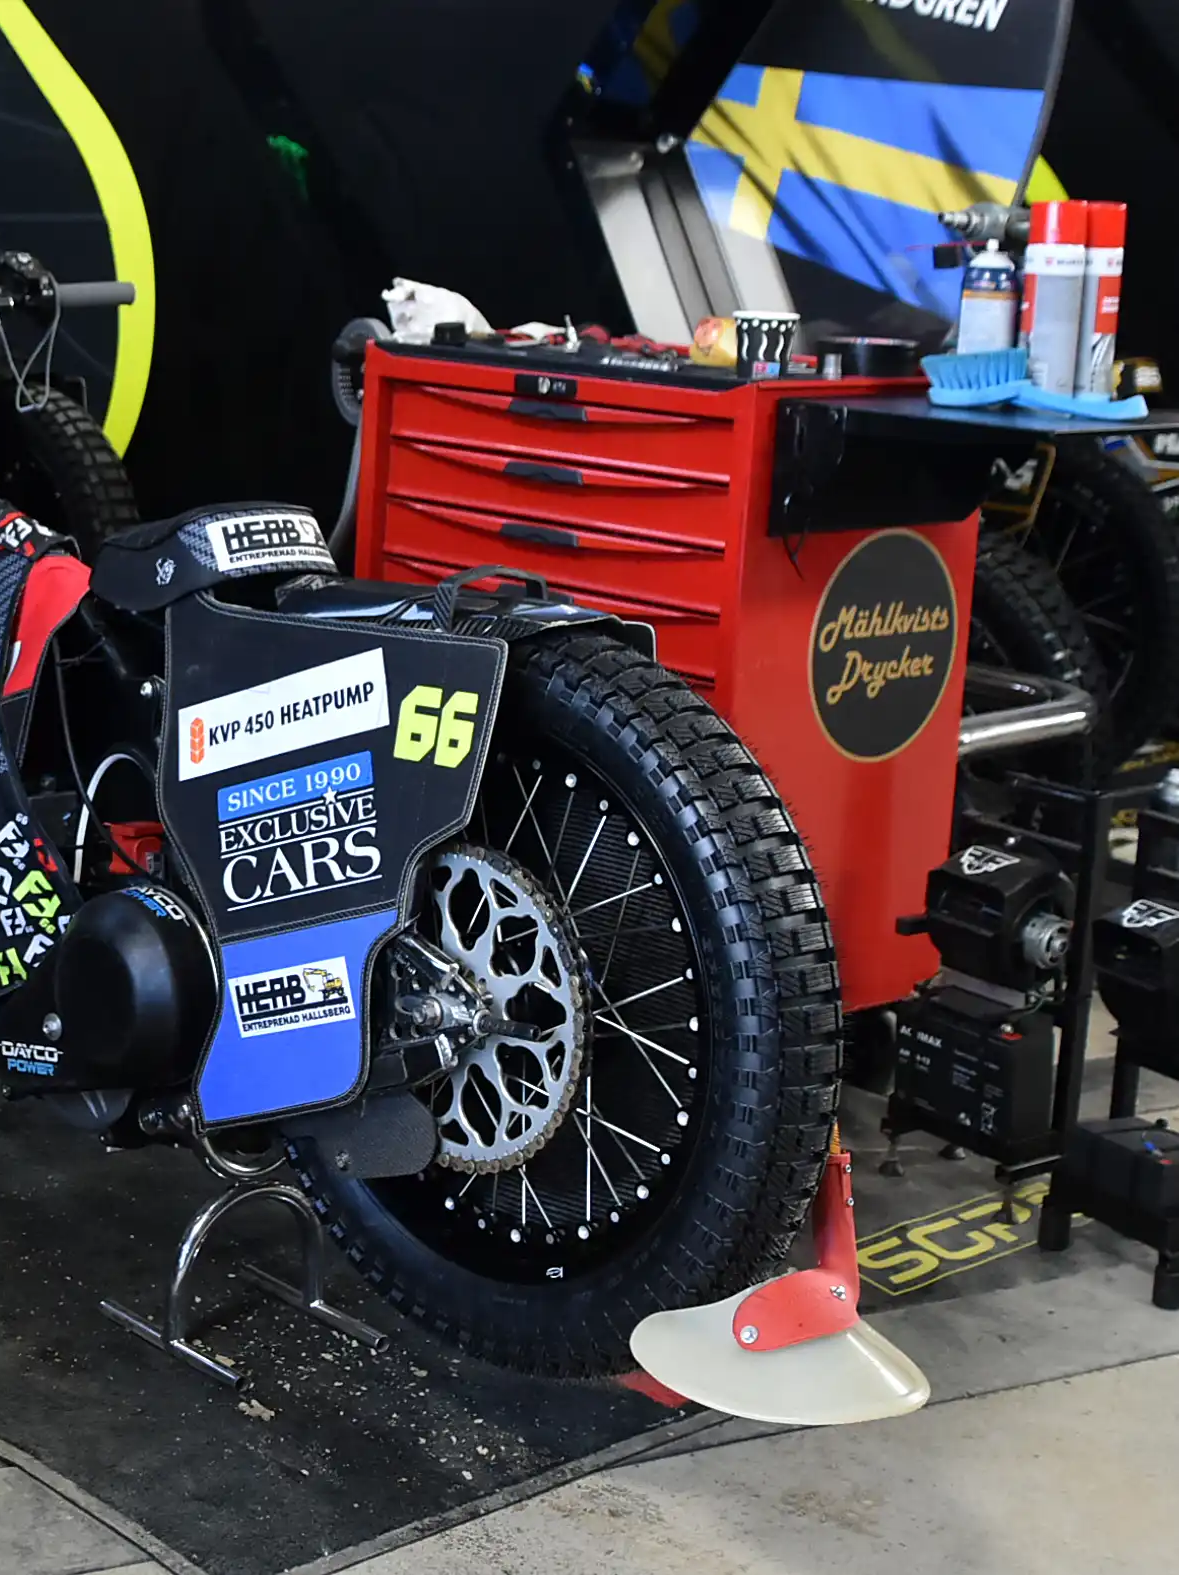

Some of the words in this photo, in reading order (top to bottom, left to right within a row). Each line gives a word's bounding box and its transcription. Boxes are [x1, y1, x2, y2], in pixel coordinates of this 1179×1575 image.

[229, 548, 296, 564] ENTREPRENAD
[819, 601, 950, 653] Mählkvists
[826, 645, 934, 705] Drycker
[208, 720, 242, 747] KVP
[244, 710, 274, 736] 450
[280, 681, 375, 726] HEATPUMP
[394, 685, 478, 768] 66
[227, 778, 296, 812] SINCE
[305, 762, 361, 792] 1990
[220, 795, 377, 853] EXCLUSIVE
[223, 827, 381, 904] CARS
[242, 1015, 300, 1033] ENTREPRENAD
[302, 1005, 351, 1022] HALLSBERG
[0, 1041, 61, 1063] DAYCO
[7, 1058, 54, 1077] POWER
